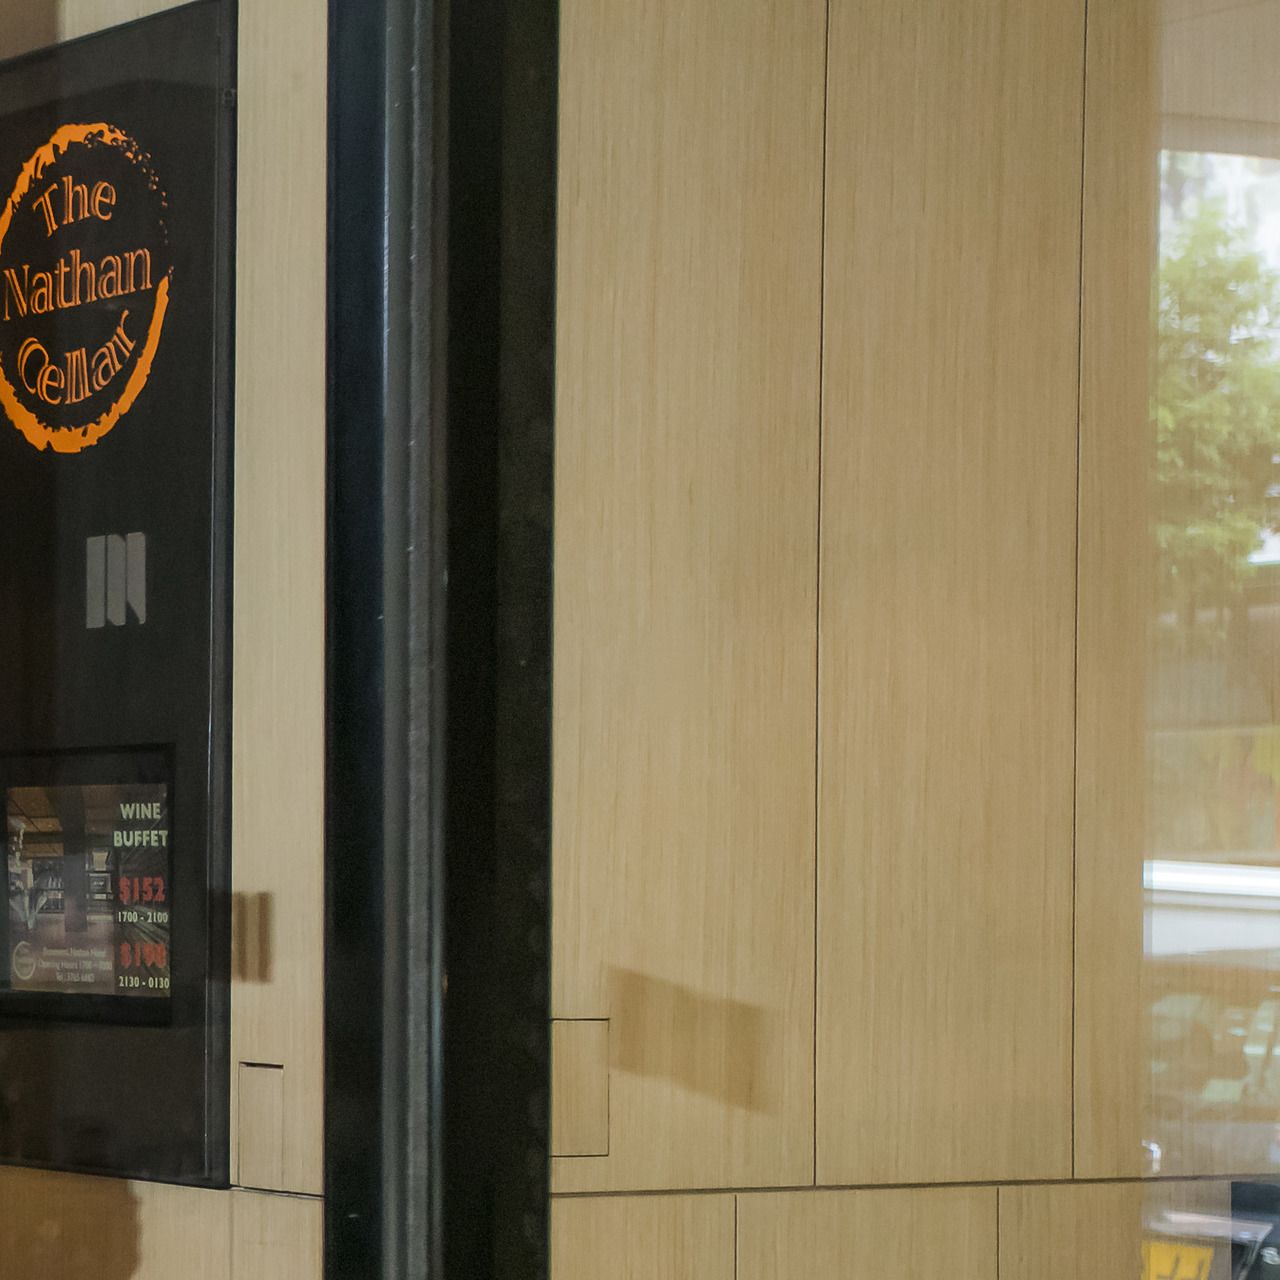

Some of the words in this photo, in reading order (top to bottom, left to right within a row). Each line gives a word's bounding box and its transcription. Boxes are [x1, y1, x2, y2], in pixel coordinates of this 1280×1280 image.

[33, 175, 117, 238] The
[3, 247, 152, 321] Nathan
[17, 308, 137, 405] Cellar
[120, 802, 161, 820] WINE
[113, 830, 168, 847] BUFFET
[119, 876, 166, 903] $152
[118, 911, 138, 923] 1700
[147, 911, 168, 923] 2100
[119, 975, 140, 988] 2130
[148, 976, 170, 989] 0130
